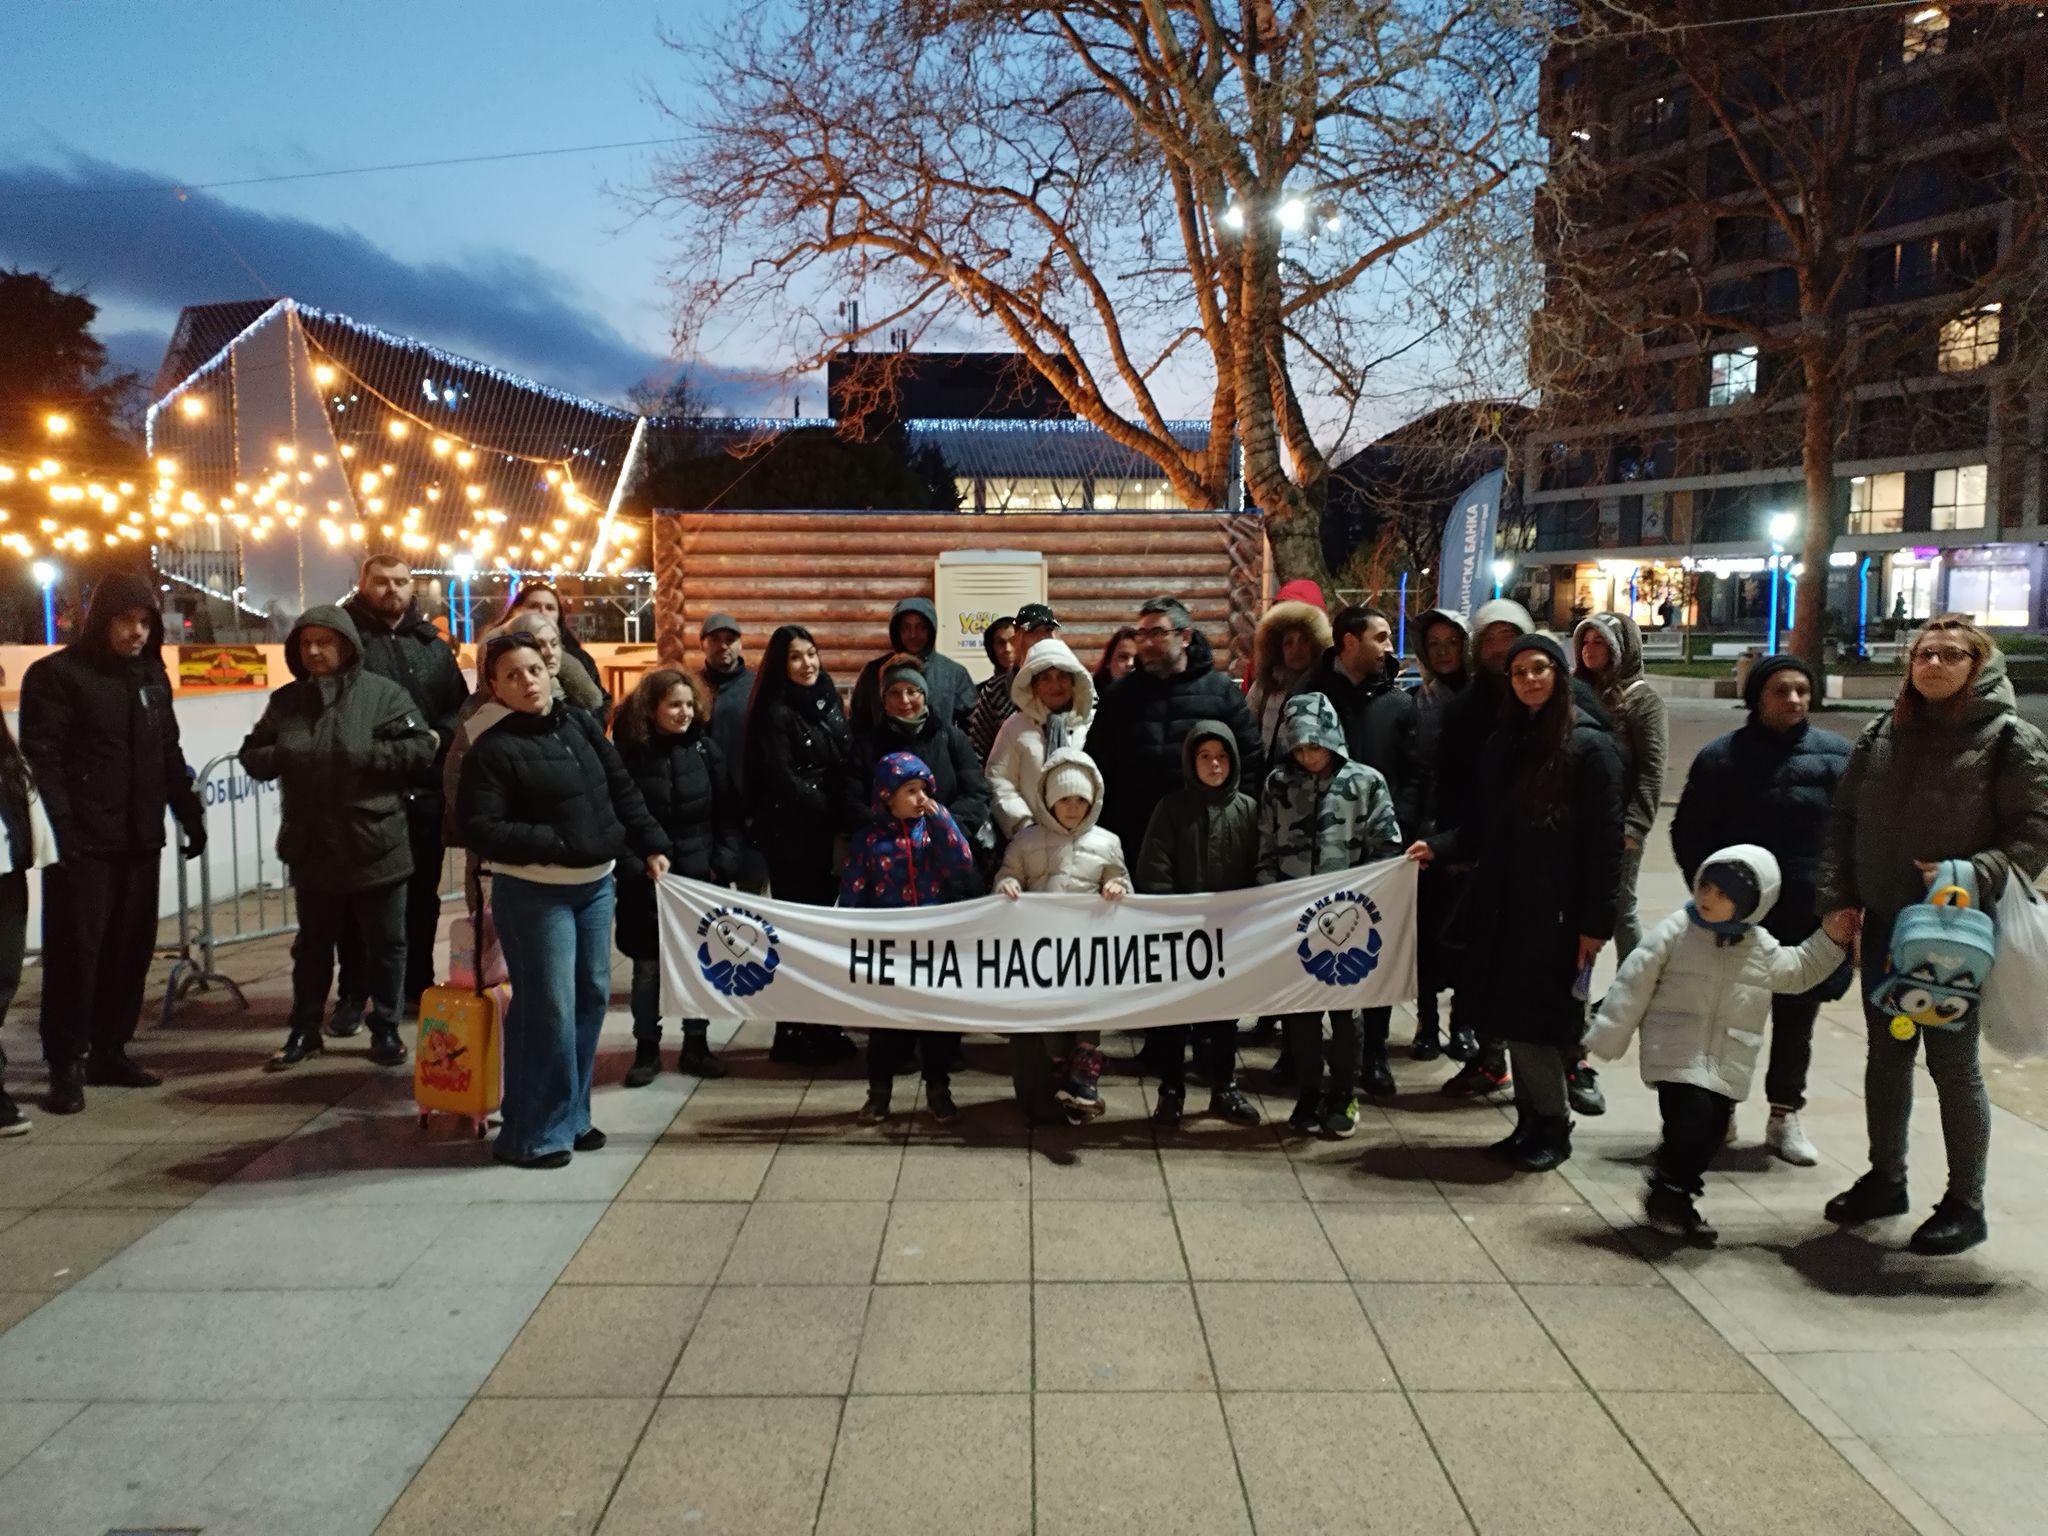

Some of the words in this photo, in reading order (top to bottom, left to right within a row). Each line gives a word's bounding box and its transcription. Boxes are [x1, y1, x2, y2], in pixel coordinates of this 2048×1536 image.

[1464, 503, 1479, 554] БАНКА
[850, 938, 896, 986] НЕ
[910, 939, 963, 988] НА
[977, 928, 1225, 988] НАСИЛИЕТО!
